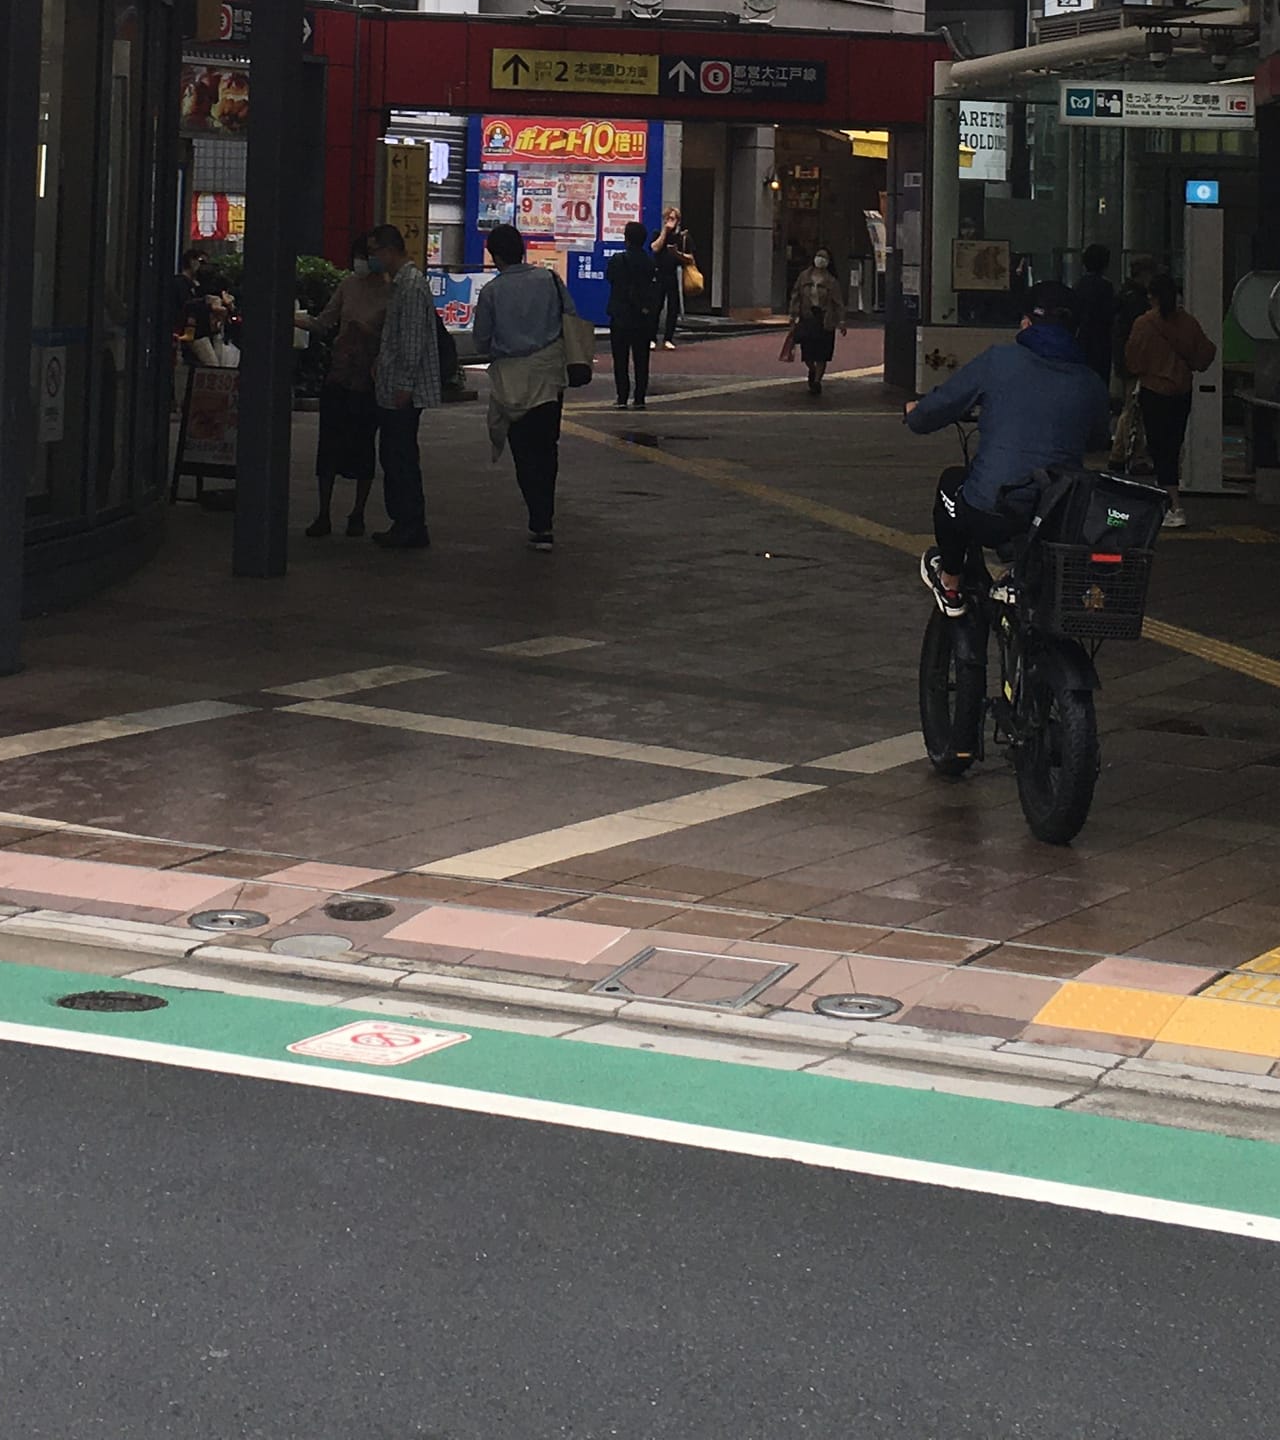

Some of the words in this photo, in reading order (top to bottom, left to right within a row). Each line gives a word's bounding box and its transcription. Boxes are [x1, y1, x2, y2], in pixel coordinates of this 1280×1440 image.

[554, 61, 569, 82] 2
[733, 65, 817, 82] 都営大江戸線
[606, 190, 627, 200] Tax
[561, 200, 592, 221] 10
